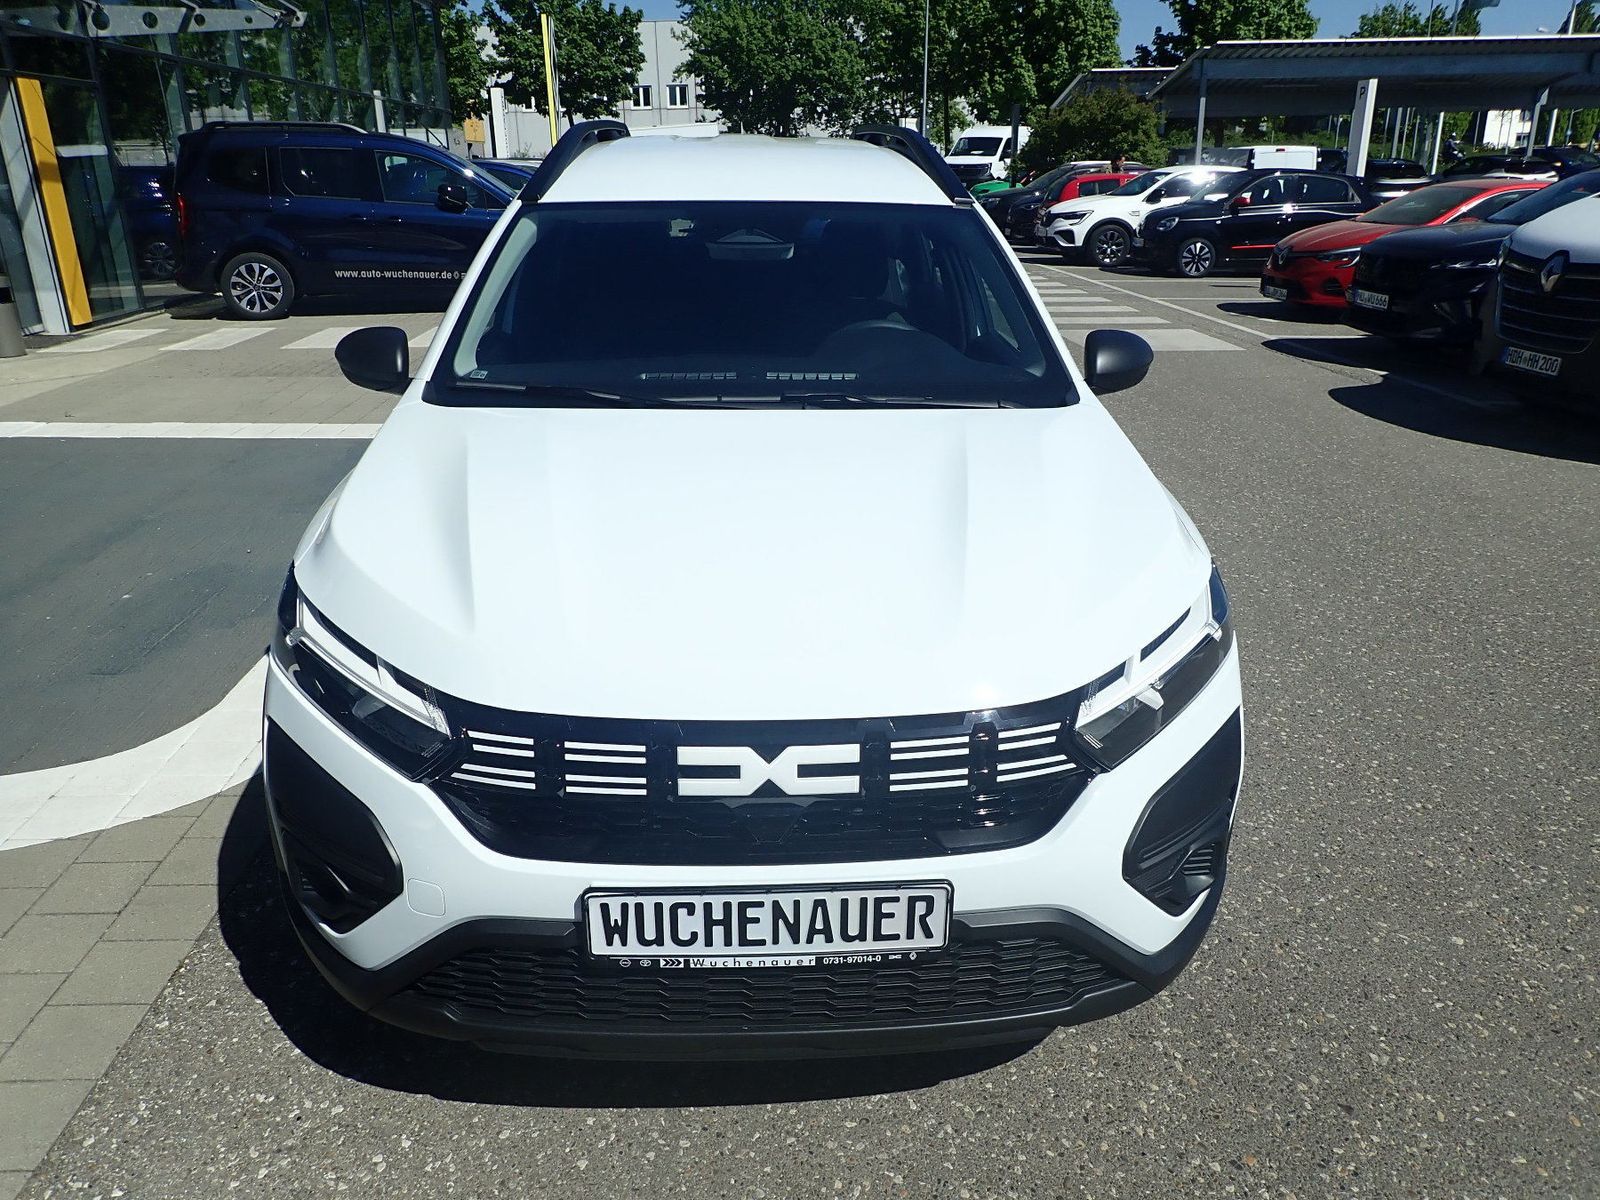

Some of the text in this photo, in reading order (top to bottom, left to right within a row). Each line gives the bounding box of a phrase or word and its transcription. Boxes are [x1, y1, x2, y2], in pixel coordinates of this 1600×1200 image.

[1359, 86, 1366, 99] P
[334, 269, 452, 279] www.auto-wuchenauer.de
[600, 894, 935, 947] WUCHENAUER
[692, 955, 881, 967] Wuchenauer 0731-97014-0
